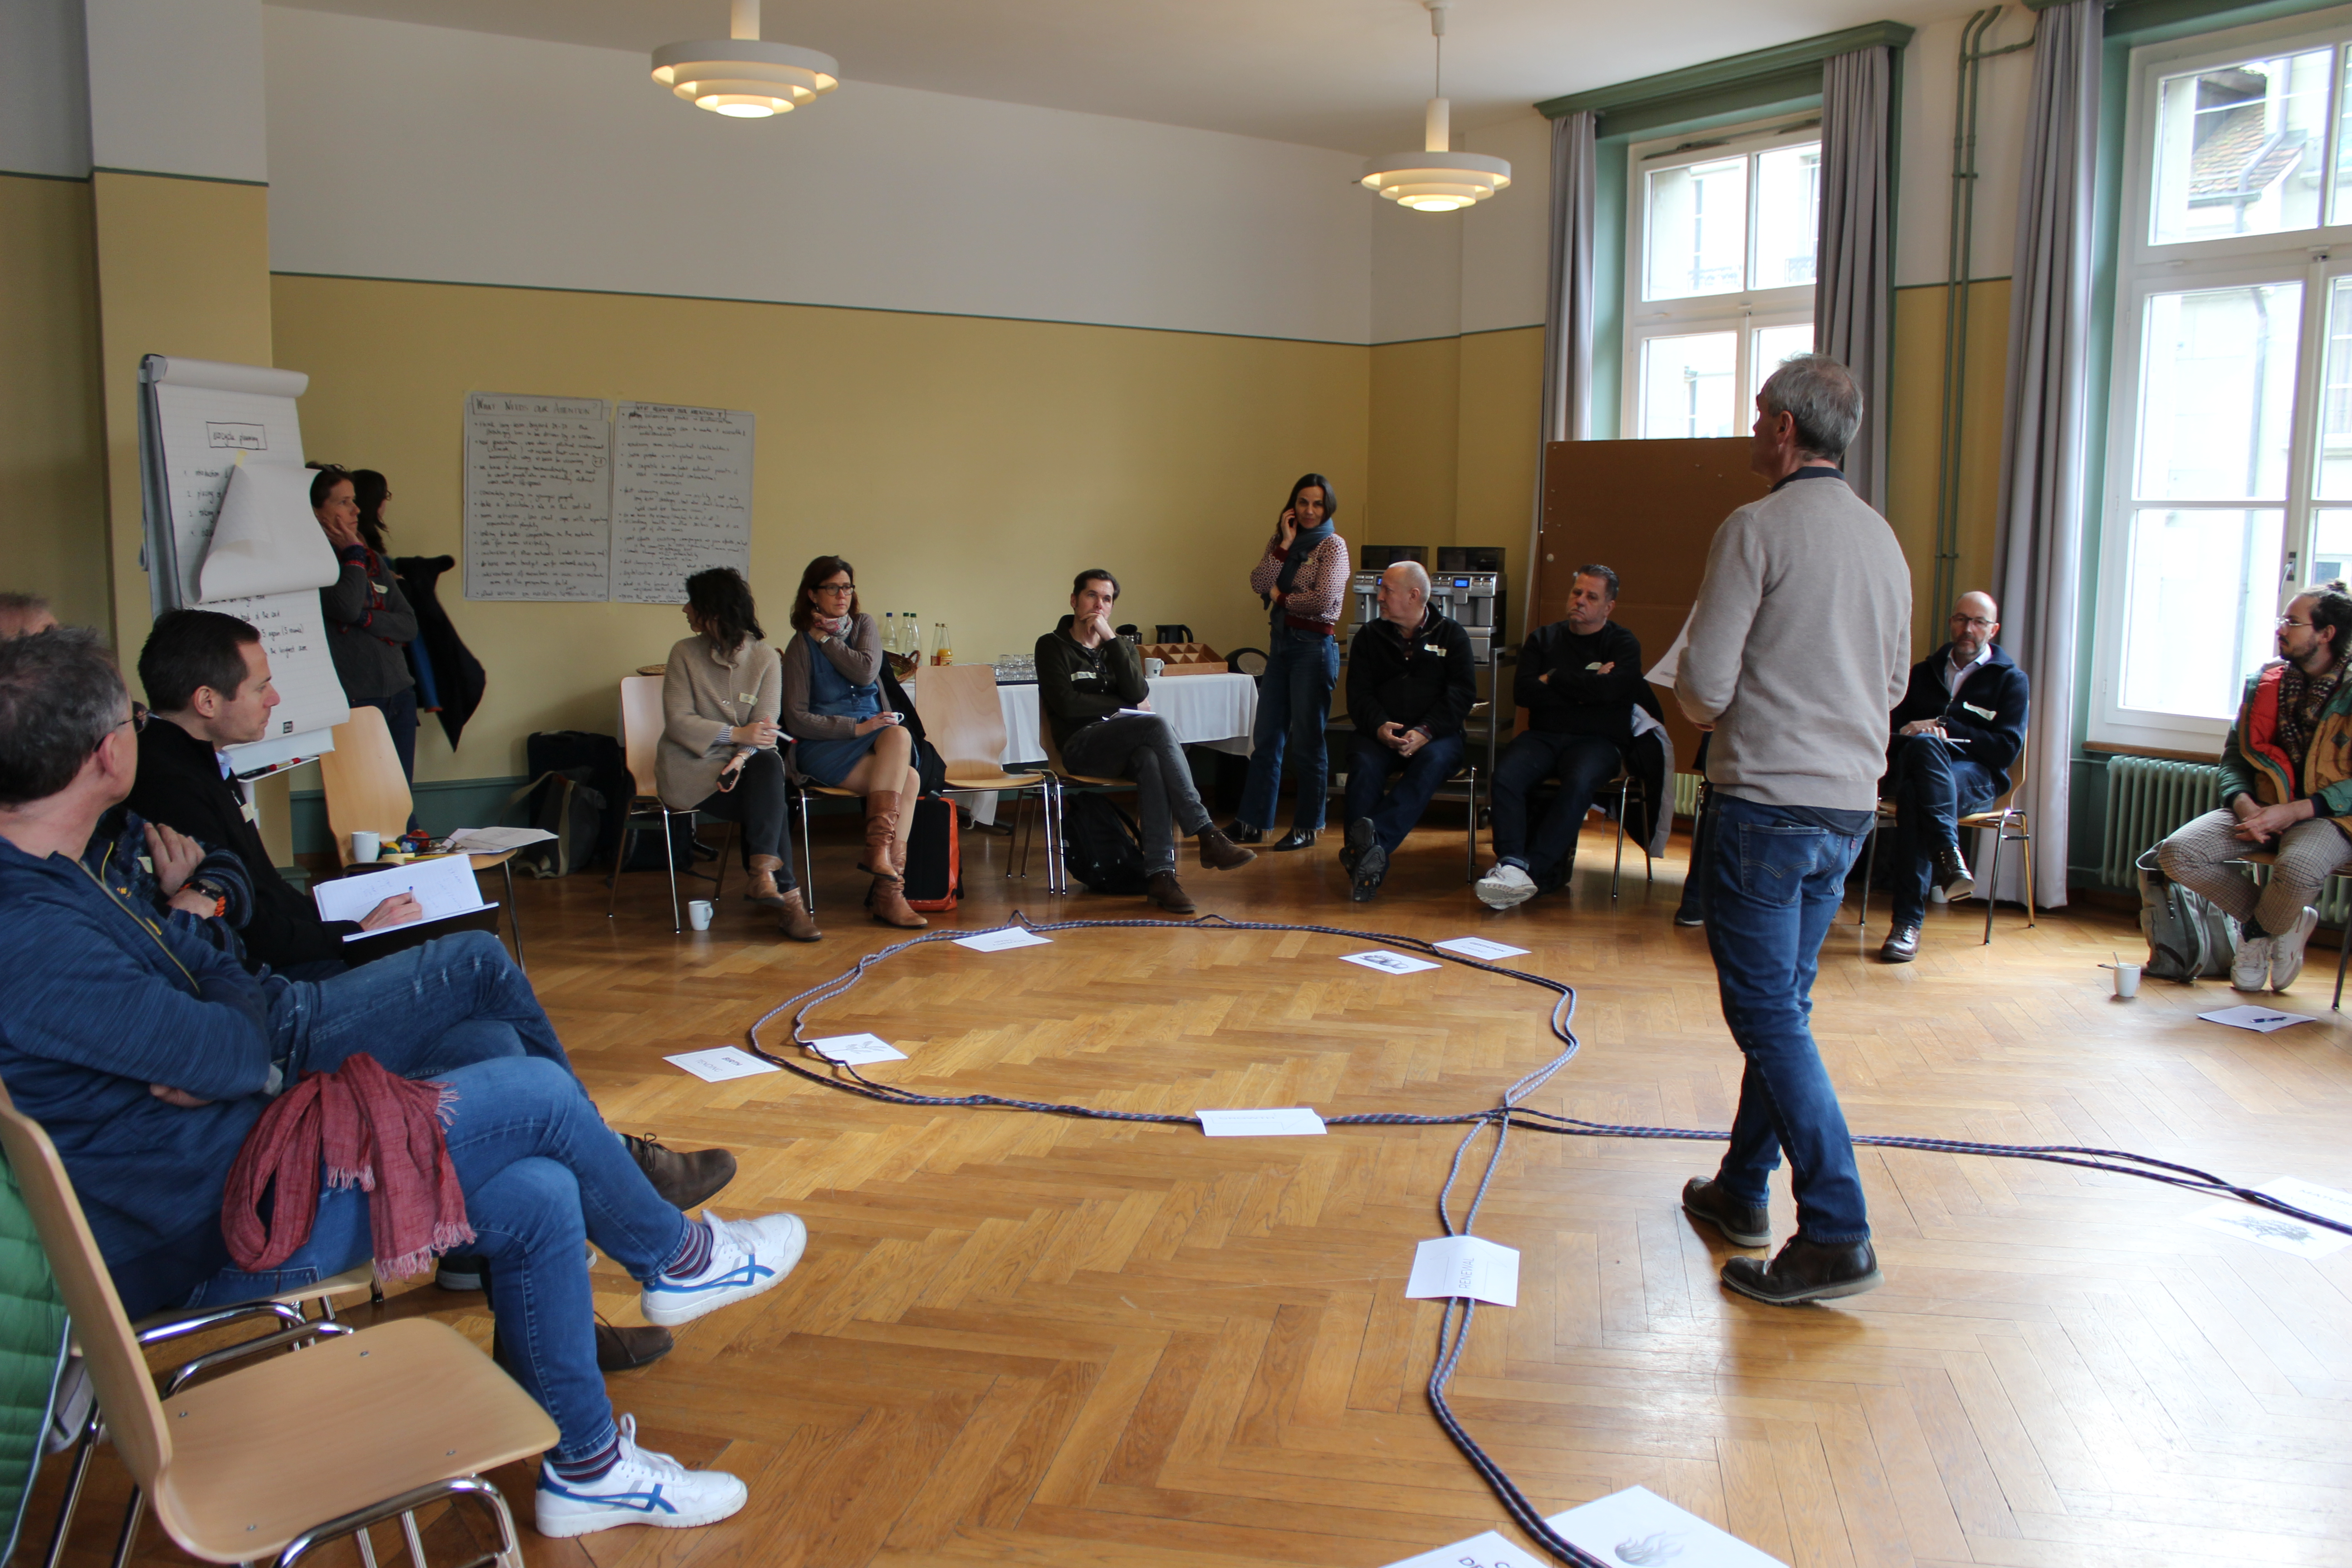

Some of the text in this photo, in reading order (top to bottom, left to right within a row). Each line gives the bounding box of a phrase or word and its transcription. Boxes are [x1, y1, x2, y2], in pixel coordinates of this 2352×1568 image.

[695, 1059, 723, 1073] TENDING
[721, 1057, 743, 1067] BIRTH
[1458, 1258, 1475, 1289] RENEWAL
